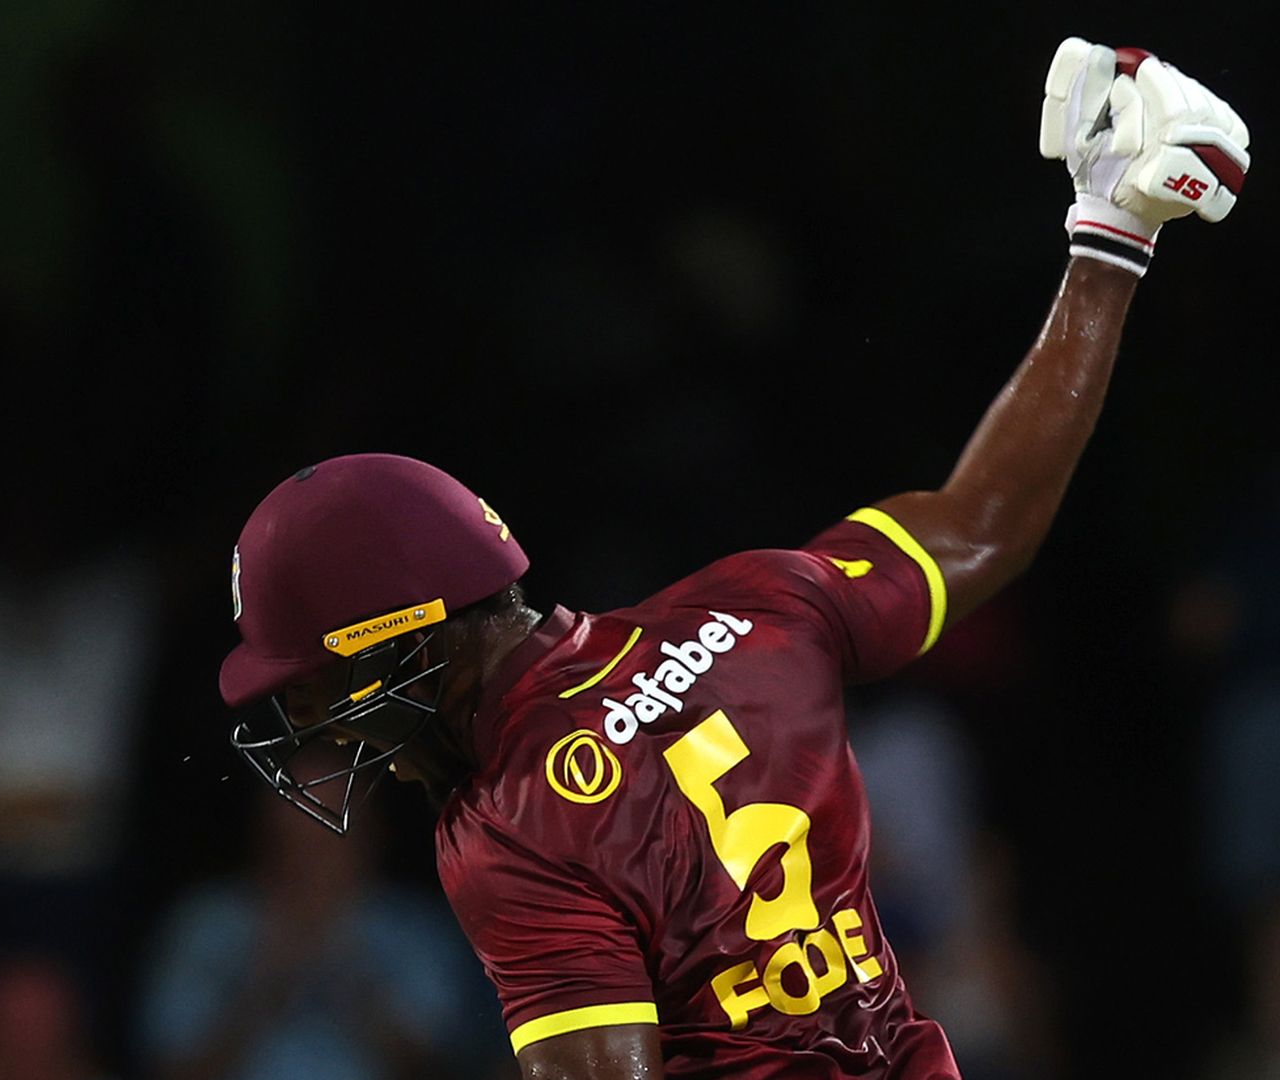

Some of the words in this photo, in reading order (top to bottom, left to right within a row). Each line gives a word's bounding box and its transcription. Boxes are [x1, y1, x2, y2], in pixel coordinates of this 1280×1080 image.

[1163, 172, 1209, 201] SF
[346, 615, 409, 641] MASURI
[601, 610, 754, 745] dafabet
[662, 708, 819, 941] 5
